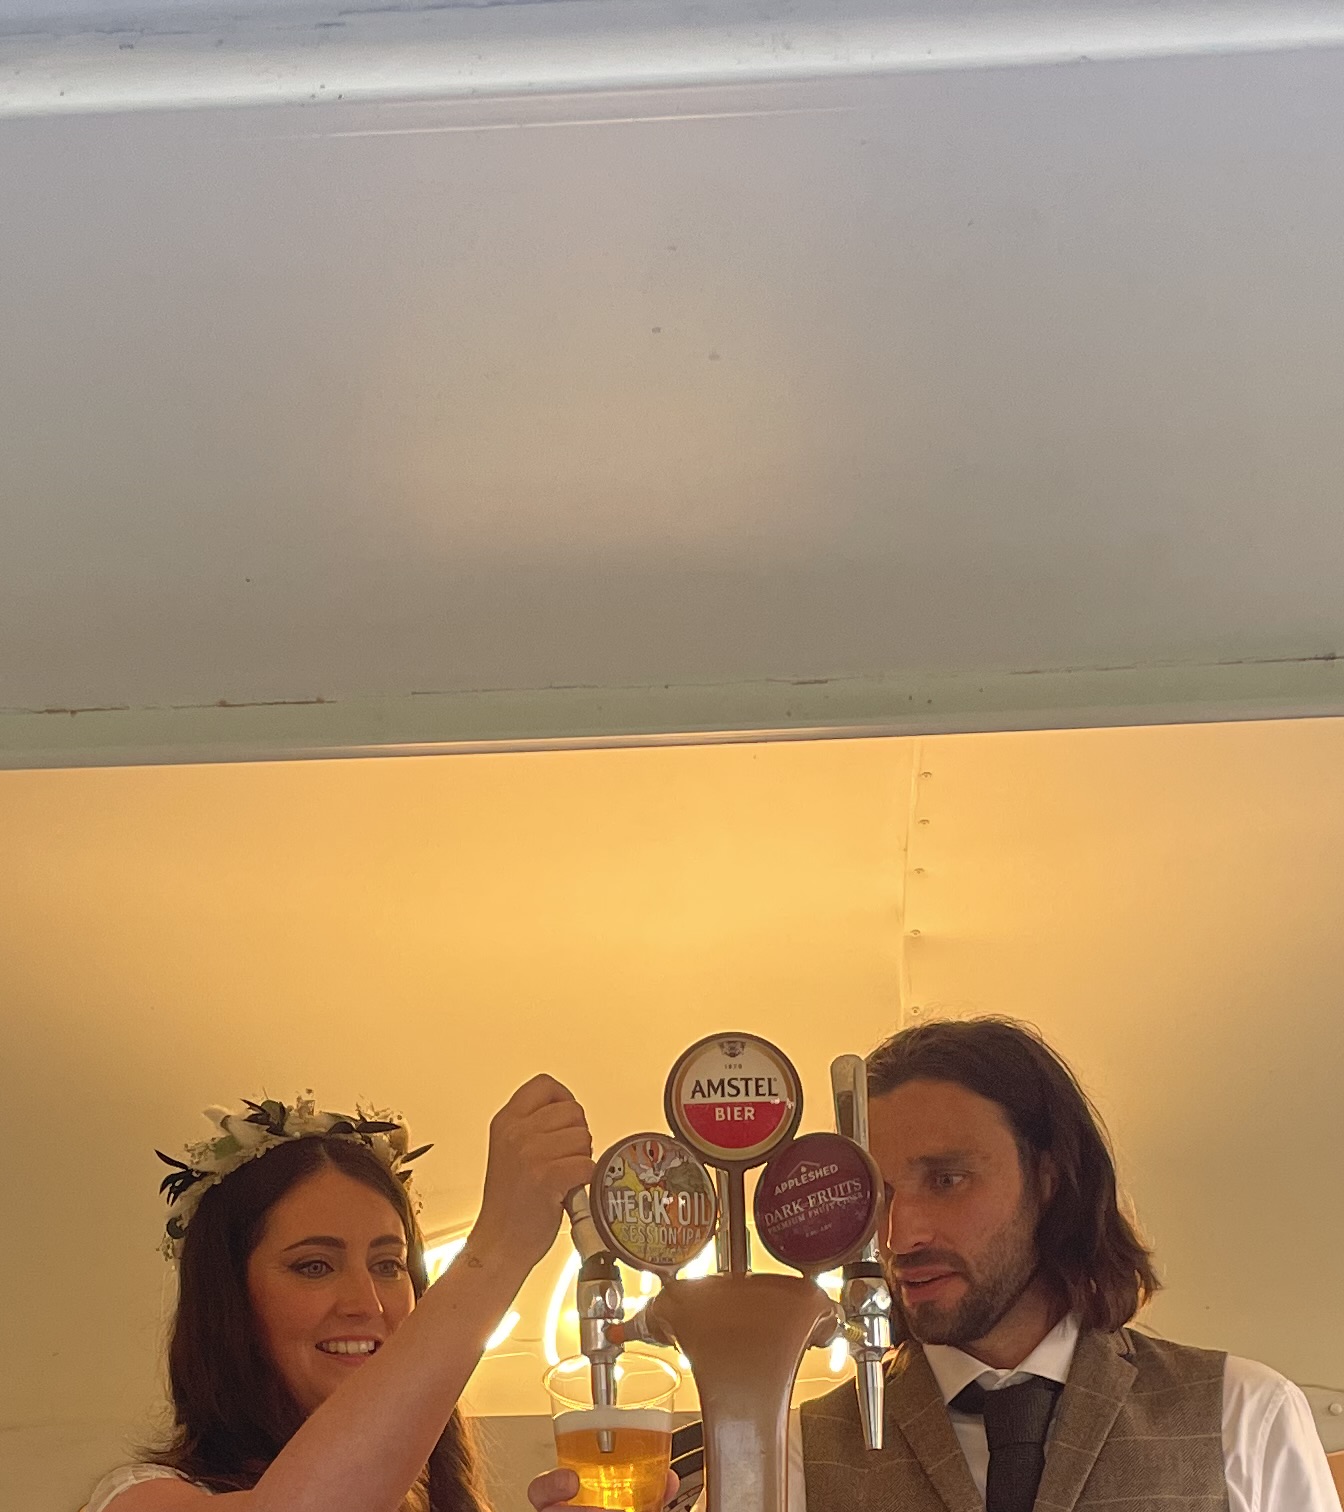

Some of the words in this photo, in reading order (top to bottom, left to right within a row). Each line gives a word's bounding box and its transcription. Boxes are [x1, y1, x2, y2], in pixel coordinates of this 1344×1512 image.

[690, 1077, 779, 1099] AMSTEL
[715, 1106, 755, 1121] BIER
[774, 1164, 839, 1196] APPLESHED
[607, 1190, 671, 1225] NECK
[678, 1191, 711, 1226] OIL
[764, 1198, 805, 1227] DARK
[807, 1178, 862, 1208] FRUITS
[621, 1225, 678, 1245] SESSION
[682, 1227, 702, 1246] IPA
